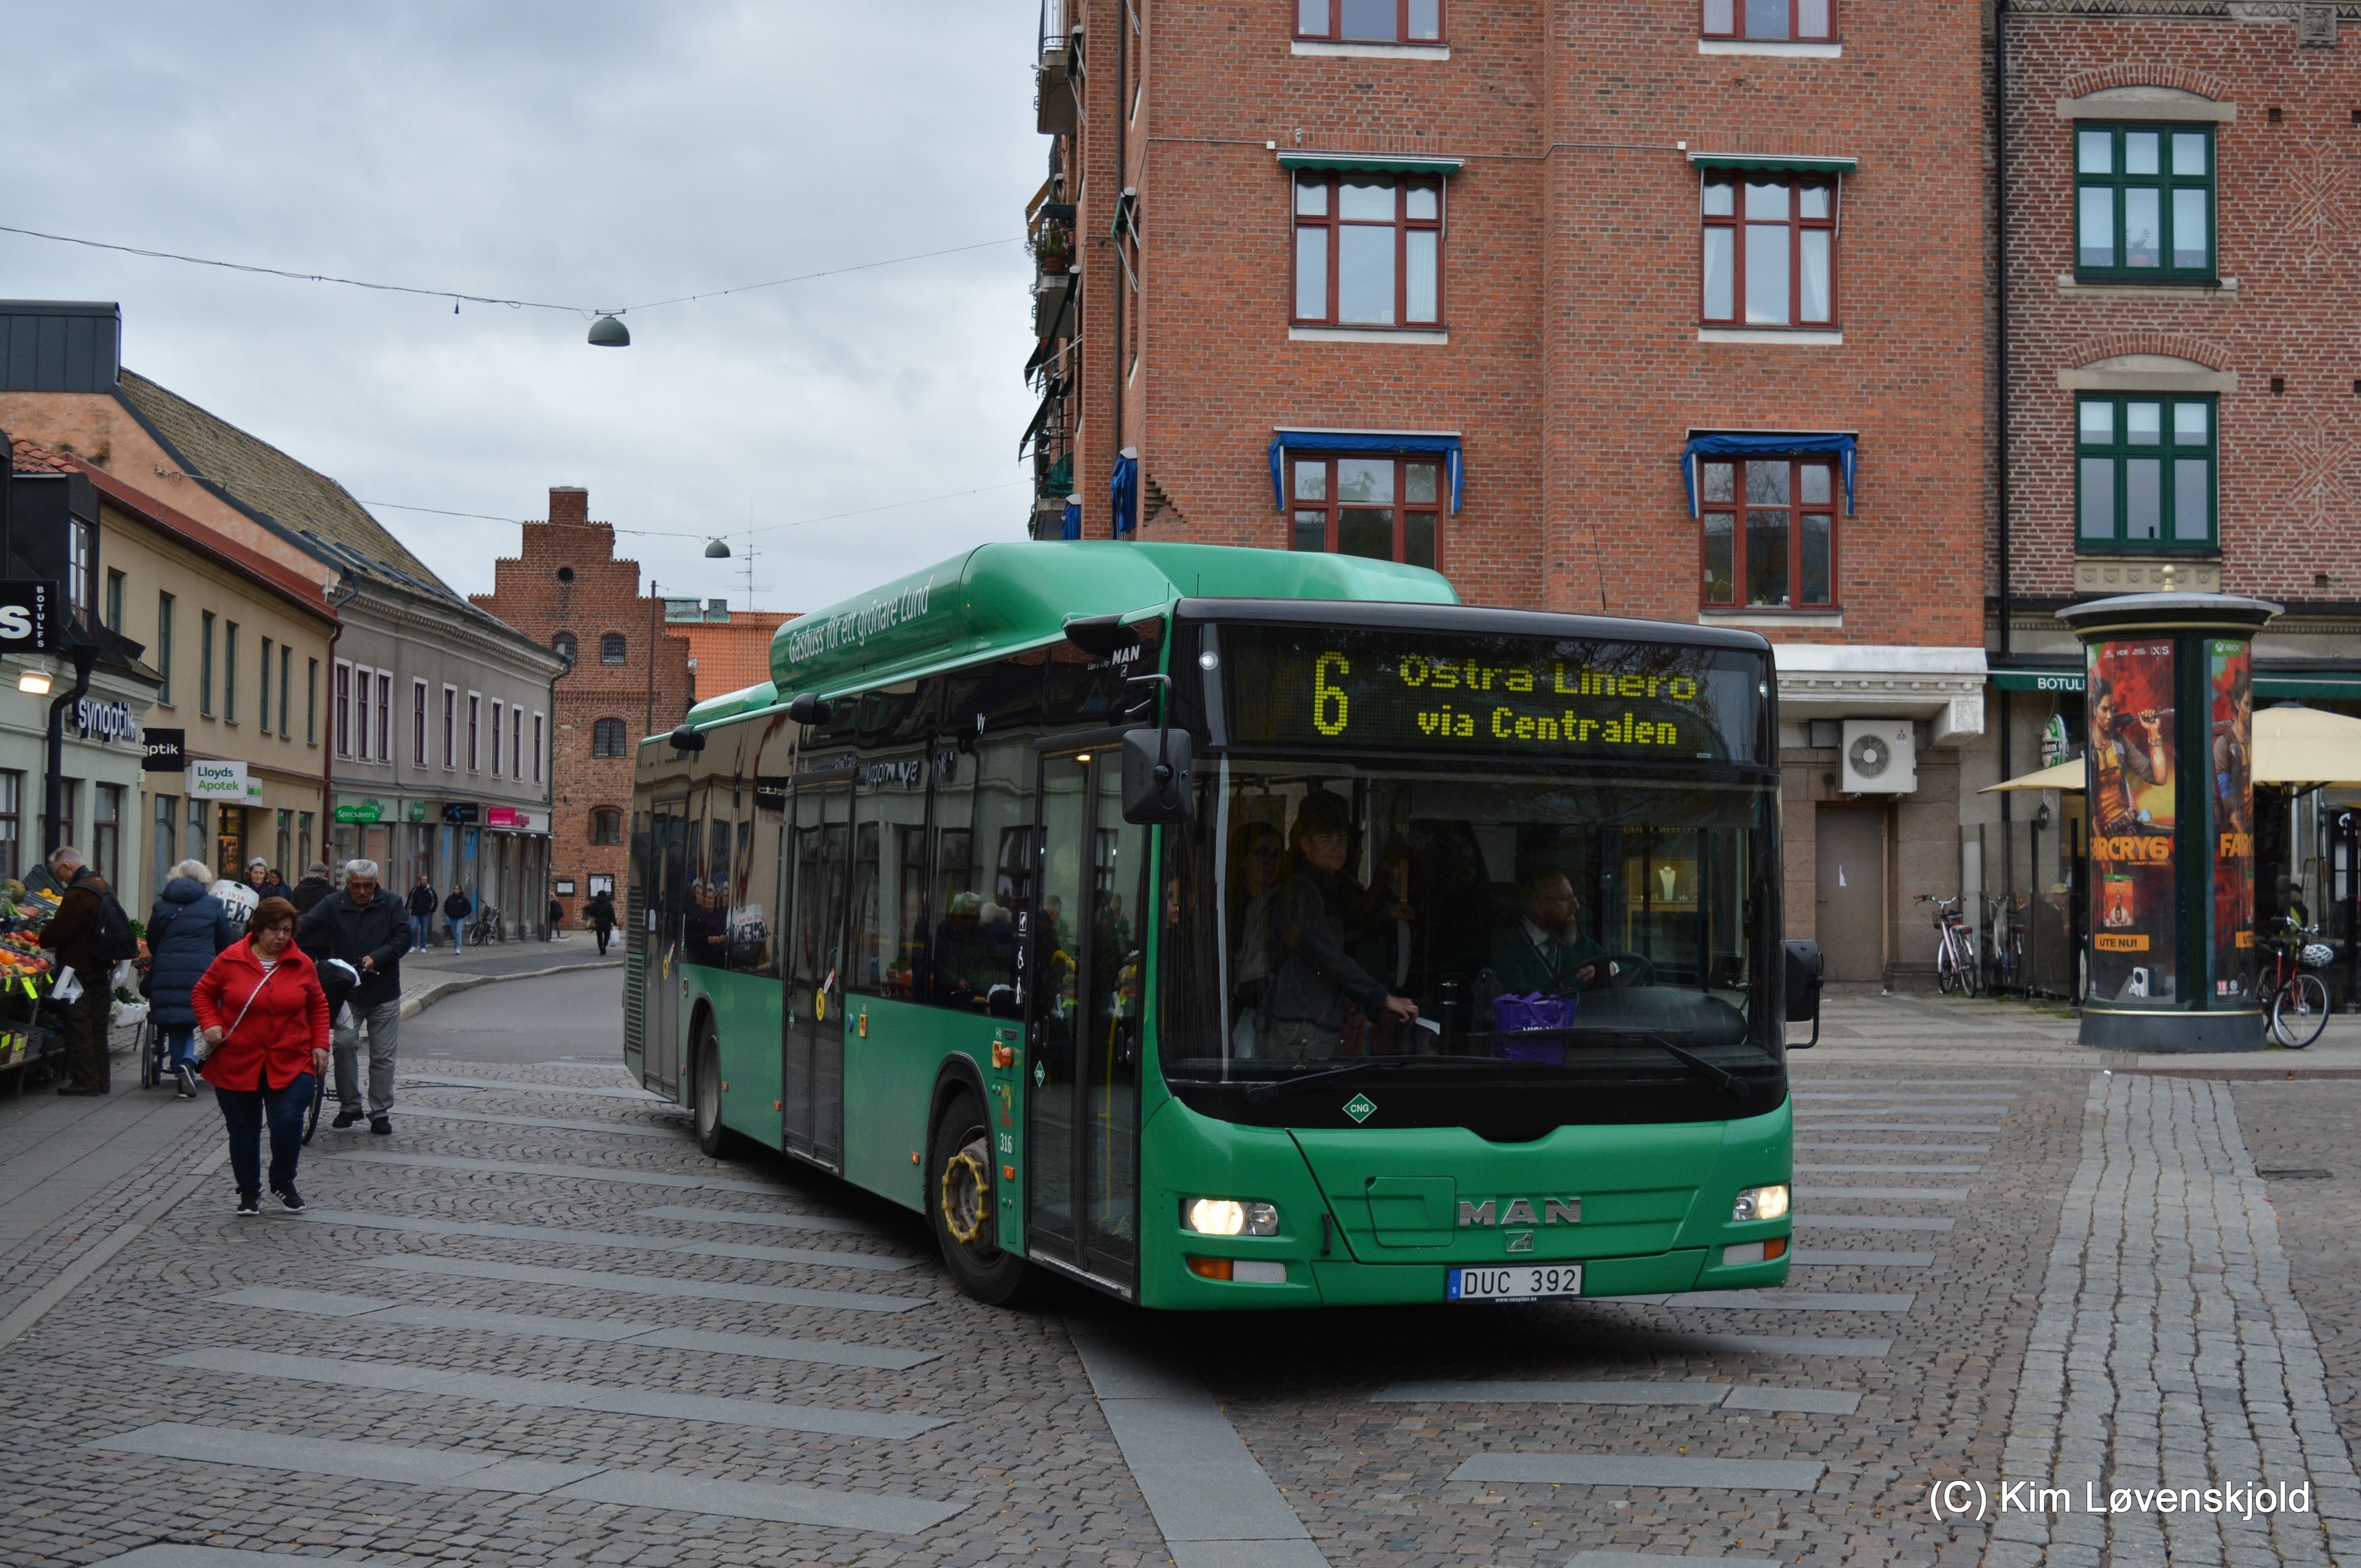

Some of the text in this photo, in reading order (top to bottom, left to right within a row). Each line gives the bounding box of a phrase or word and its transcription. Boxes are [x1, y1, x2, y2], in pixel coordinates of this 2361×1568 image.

[789, 574, 934, 664] Gasbuss för ett grönare Lund
[1112, 645, 1140, 665] MAN
[1399, 654, 1696, 700] Östra Linero
[1314, 651, 1350, 736] 6
[78, 699, 134, 743] synoptik
[977, 713, 985, 735] Vy
[1418, 704, 1677, 745] via Centralen
[198, 767, 234, 778] Lloyds
[198, 780, 239, 792] Apotek
[228, 891, 245, 901] 1926
[2100, 939, 2137, 947] UTE NU!
[1350, 1103, 1369, 1113] CNG
[1000, 1132, 1012, 1154] 316
[1459, 1196, 1581, 1227] MAN
[1464, 1269, 1576, 1295] DUC 392
